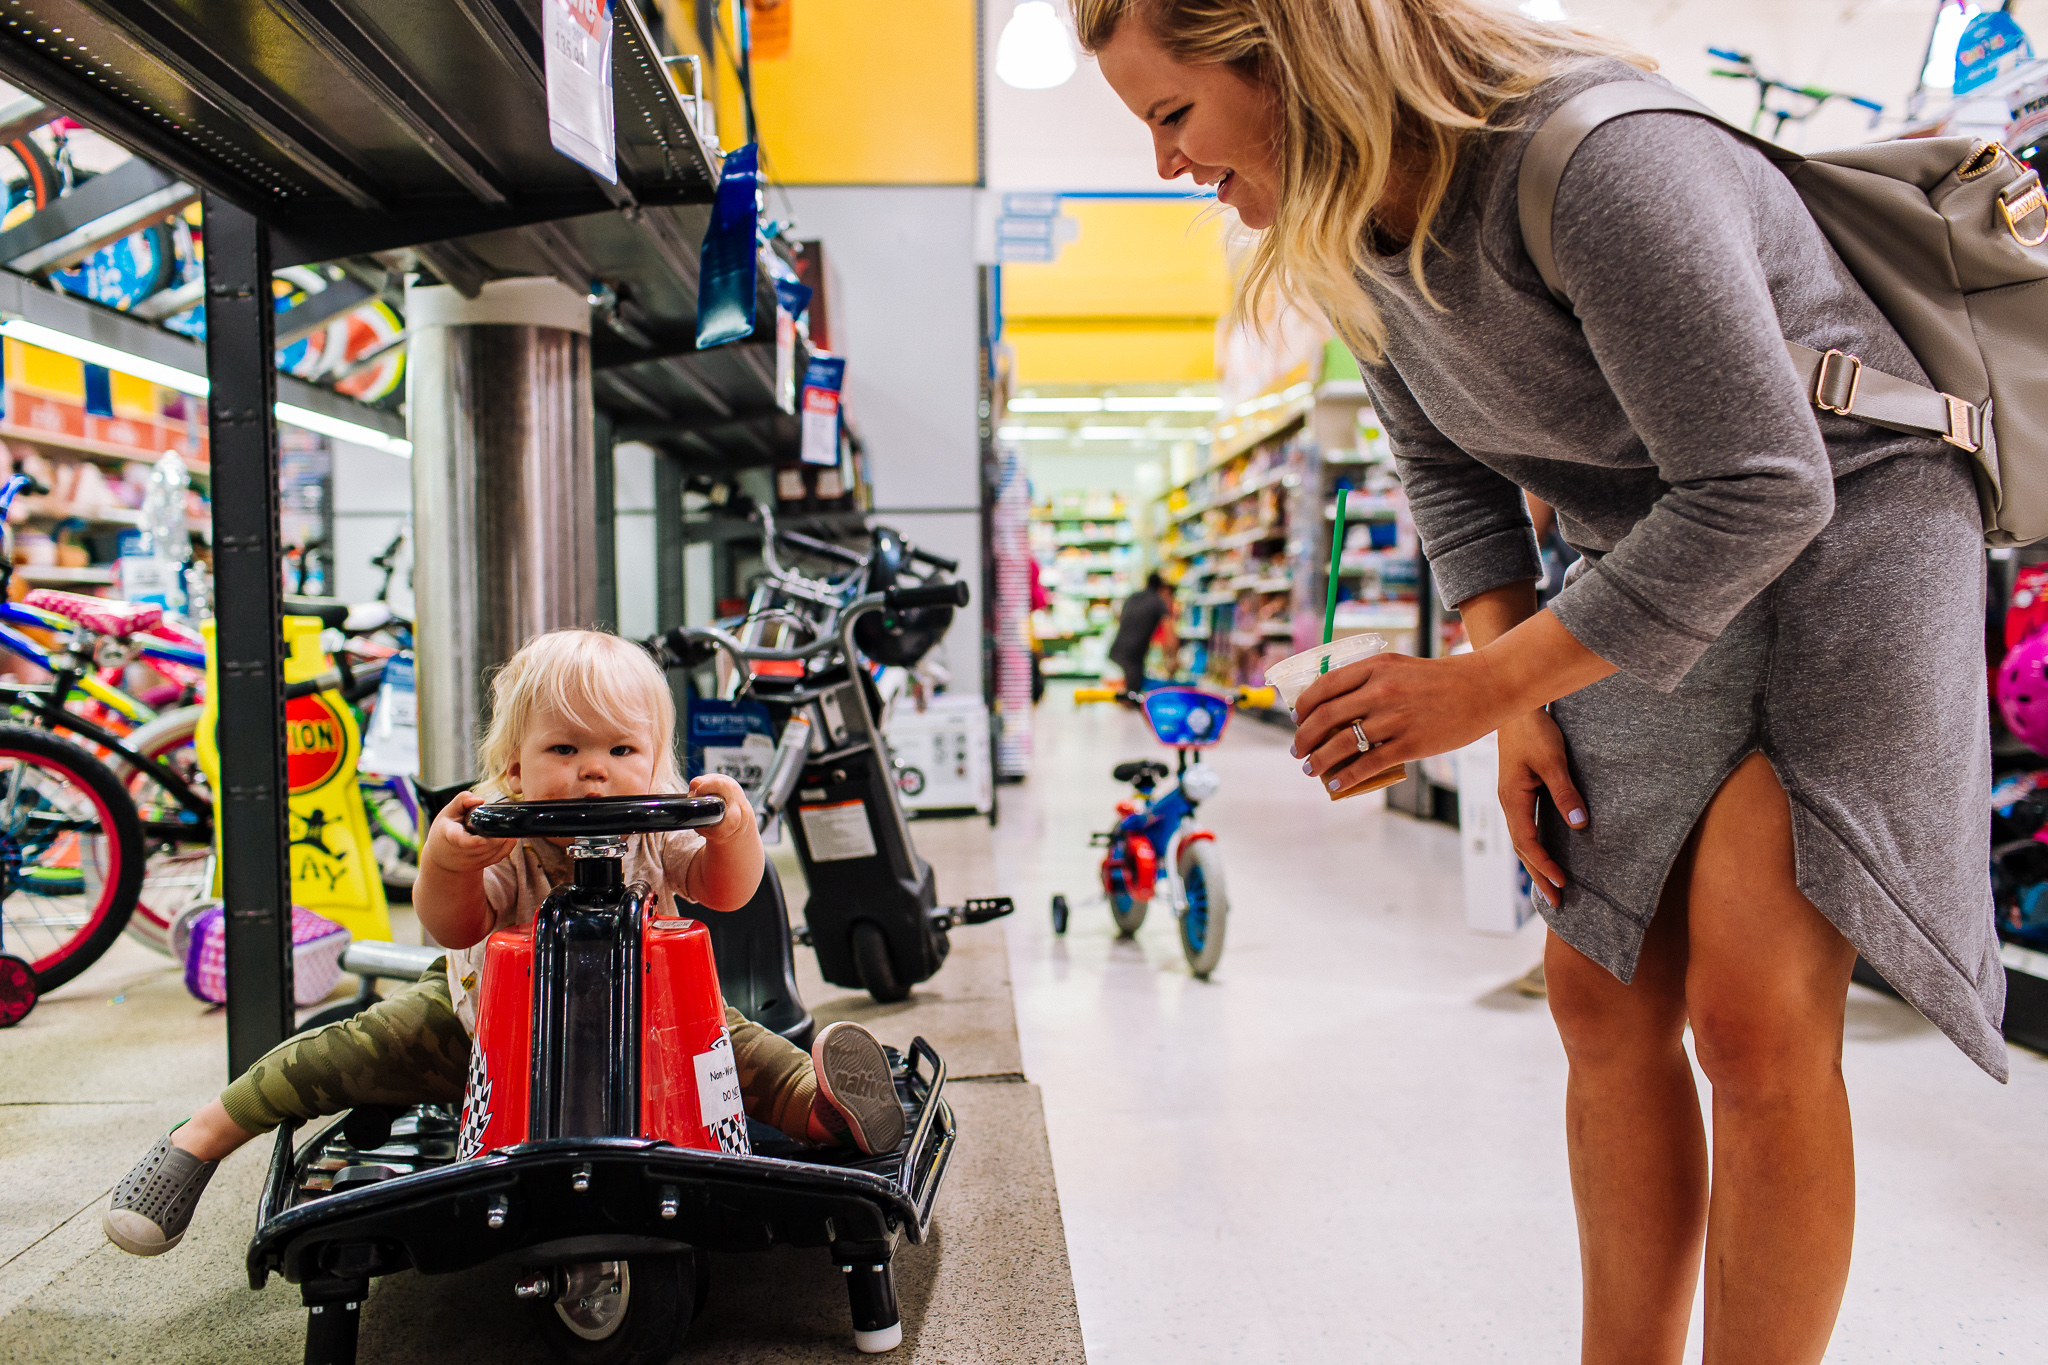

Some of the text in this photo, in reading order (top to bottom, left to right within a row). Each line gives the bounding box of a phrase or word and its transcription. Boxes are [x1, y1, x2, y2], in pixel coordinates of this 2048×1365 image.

[290, 724, 334, 750] ION
[296, 854, 347, 891] AY
[722, 1090, 732, 1101] DO
[835, 1072, 893, 1100] native
